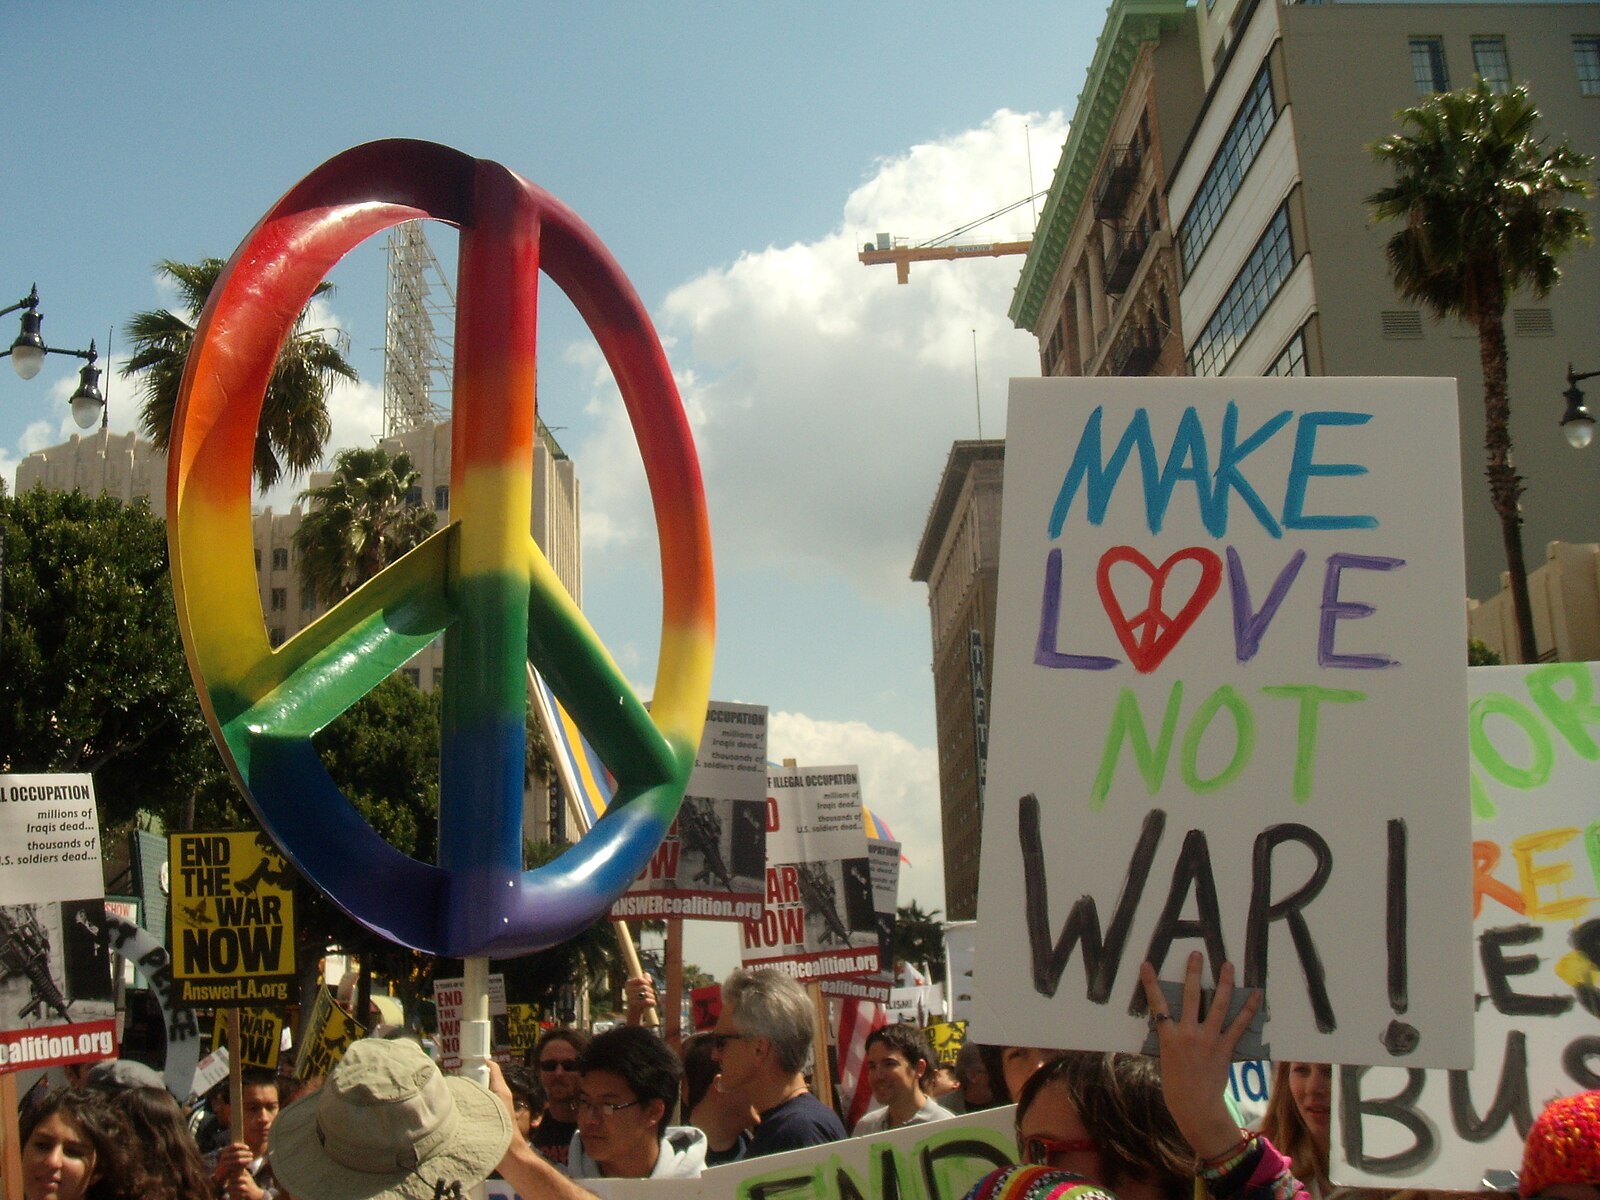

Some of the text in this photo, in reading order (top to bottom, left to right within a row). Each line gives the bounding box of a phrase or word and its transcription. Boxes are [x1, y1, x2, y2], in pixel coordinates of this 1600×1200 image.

[1047, 400, 1381, 540] MAKE
[1089, 681, 1367, 812] NOT
[773, 776, 804, 788] ILLEGAL
[806, 773, 857, 787] OCCUPATION
[10, 785, 90, 802] OCCUPATION
[38, 808, 92, 819] millions of
[27, 821, 94, 835] Iraqis dead...
[28, 837, 95, 850] thousands of
[180, 837, 231, 867] END
[18, 854, 58, 865] soldiers
[62, 851, 97, 862] dead...
[180, 868, 231, 897] THE
[214, 896, 282, 926] WAR
[611, 896, 762, 919] ANSWERcoalition.org
[743, 908, 805, 949] NOW
[183, 925, 283, 974] NOW
[182, 978, 288, 1000] AnswerLA.org
[437, 991, 463, 1007] END
[440, 1009, 456, 1019] THE
[442, 1037, 460, 1053] NO
